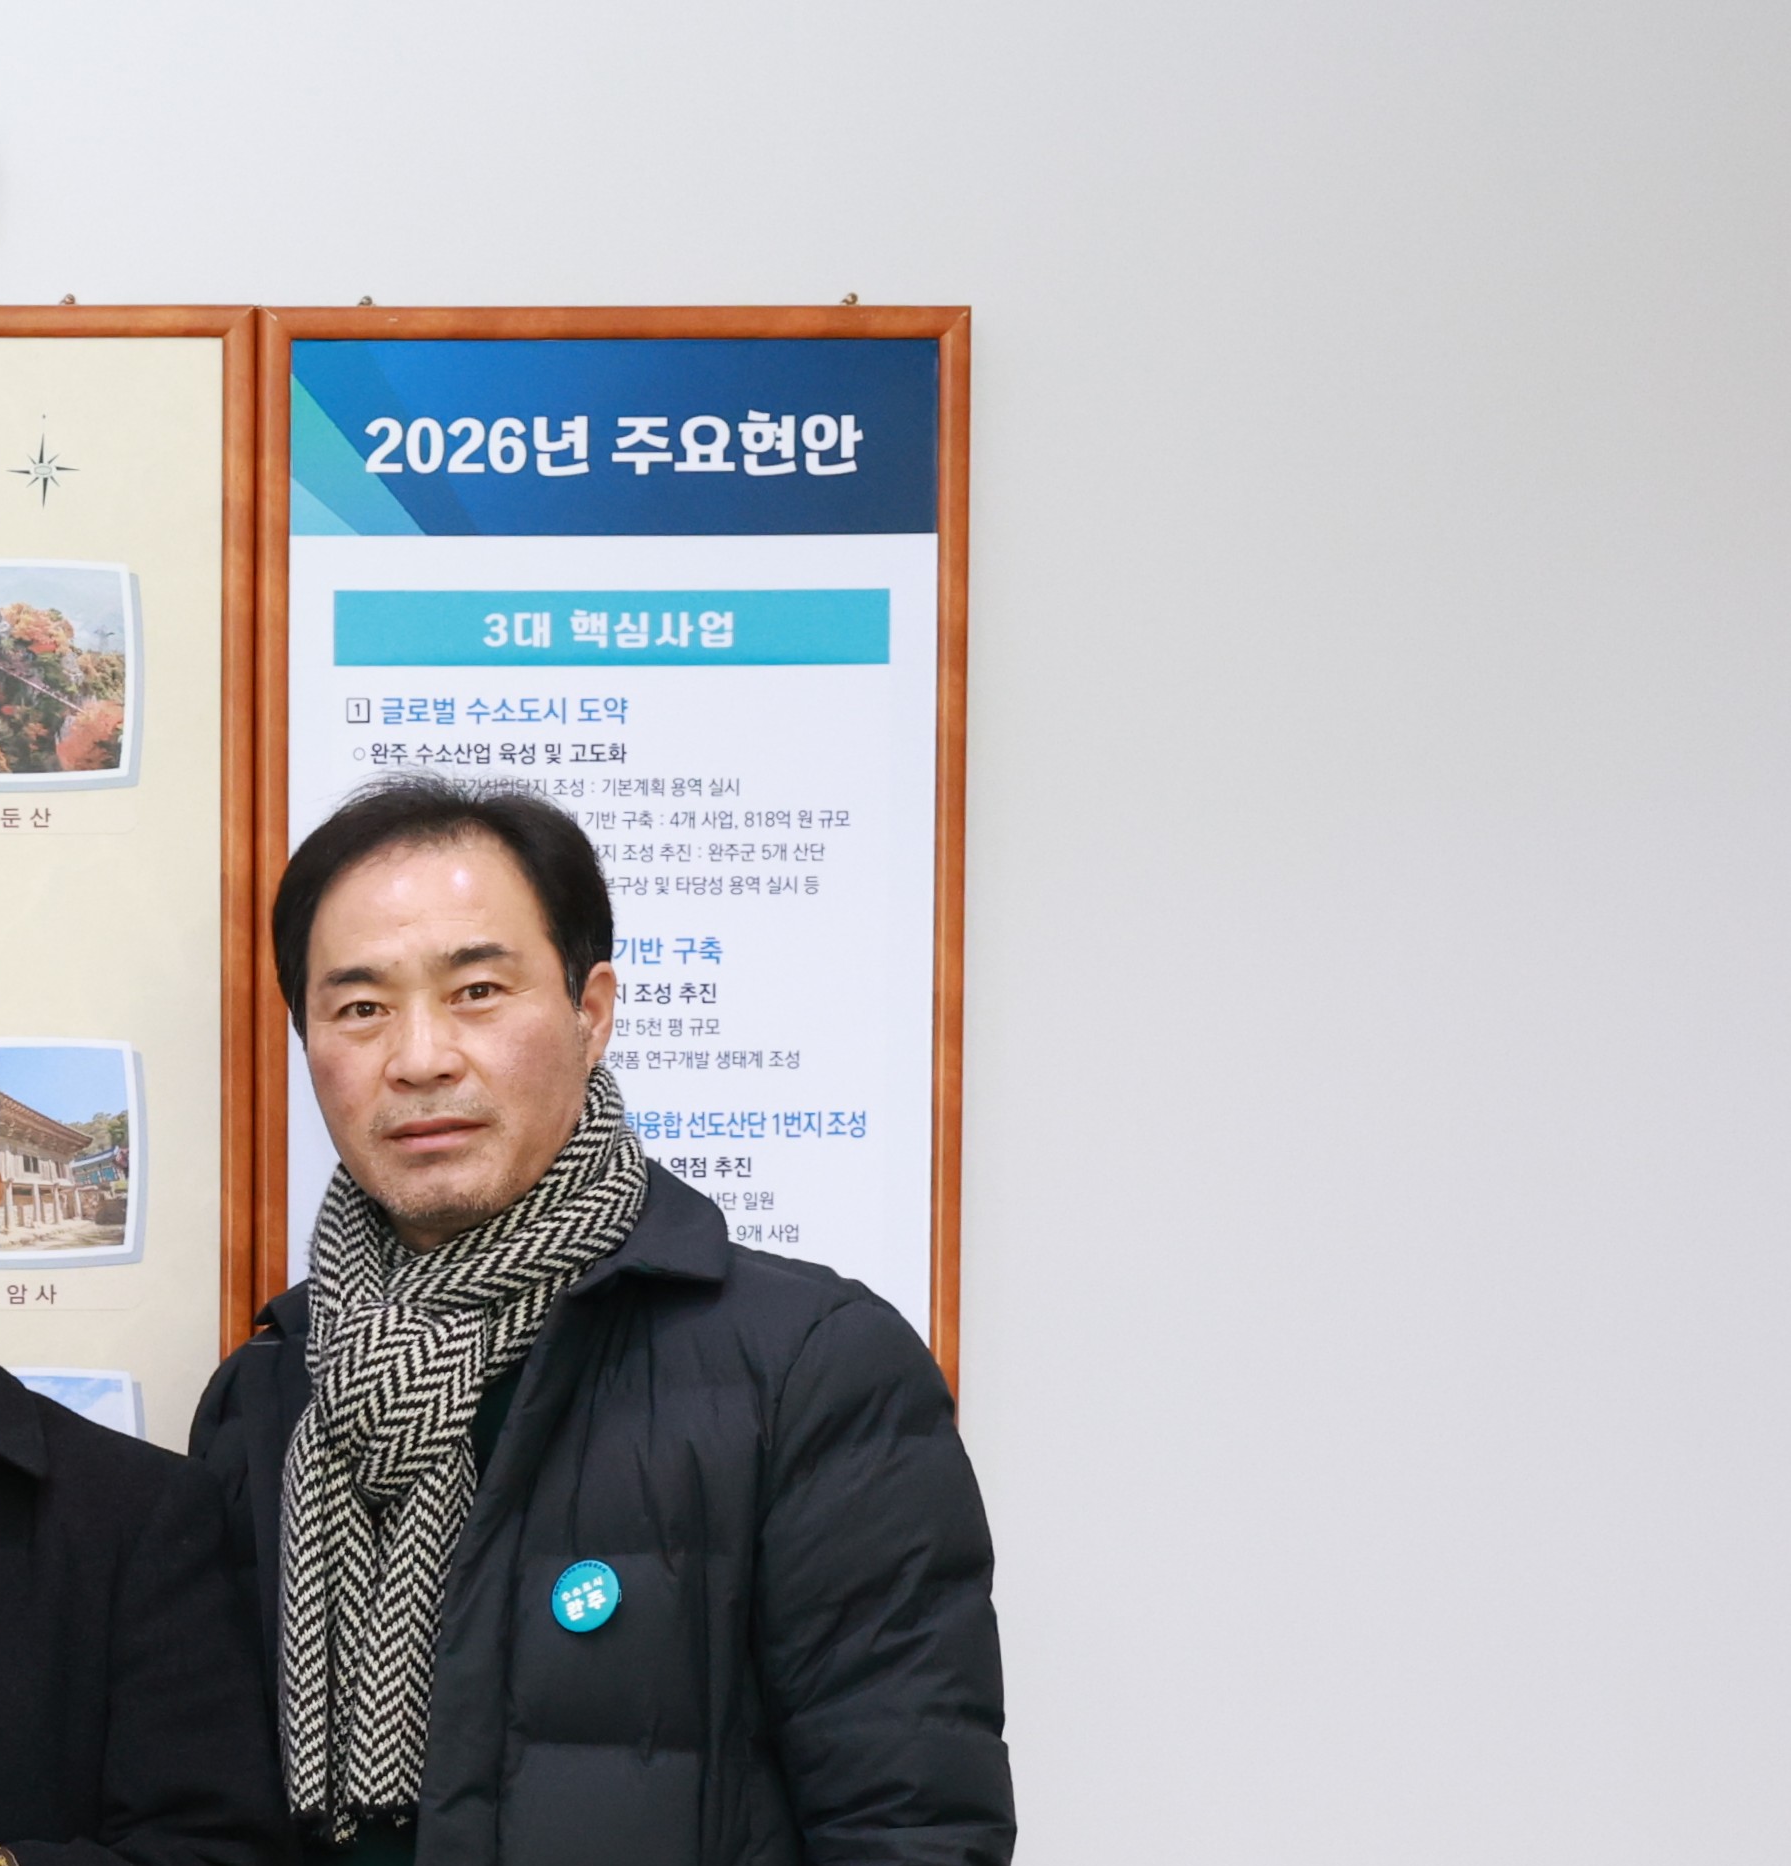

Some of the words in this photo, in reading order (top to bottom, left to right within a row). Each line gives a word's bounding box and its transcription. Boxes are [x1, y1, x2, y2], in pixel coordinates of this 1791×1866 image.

[364, 414, 590, 477] 2026년
[611, 409, 864, 477] 주요현안
[482, 611, 553, 650] 3대
[569, 608, 735, 651] 핵심사업
[379, 698, 456, 726] 글로벌
[466, 698, 568, 726] 수소도시
[576, 697, 630, 726] 도약
[370, 743, 408, 765] 완주
[415, 743, 491, 765] 수소산업
[499, 742, 536, 765] 육성
[544, 742, 562, 765] 및
[569, 742, 627, 765] 고도화
[553, 778, 585, 797] 조성
[602, 778, 666, 797] 기본계획
[670, 778, 703, 797] 용역
[708, 778, 741, 797] 실시
[585, 810, 617, 829] 기반
[621, 810, 654, 829] 구축
[669, 810, 697, 829] 4개
[701, 810, 739, 830] 사업,
[744, 810, 791, 829] 818억
[797, 810, 813, 829] 원
[818, 810, 851, 829] 규모
[622, 843, 654, 862] 조성
[659, 843, 691, 862] 추진
[707, 843, 756, 862] 완주군
[761, 843, 788, 862] 5개
[792, 843, 825, 862] 산단
[654, 877, 670, 896] 및
[675, 877, 724, 896] 타당성
[729, 877, 761, 896] 용역
[766, 876, 799, 896] 실시
[804, 876, 820, 895] 등
[613, 937, 663, 965] 기반
[672, 937, 724, 965] 구축
[634, 982, 672, 1004] 조성
[678, 982, 717, 1004] 추진
[636, 1018, 662, 1037] 5천
[668, 1018, 684, 1037] 평
[688, 1018, 721, 1037] 규모
[646, 1050, 710, 1070] 연구개발
[715, 1050, 763, 1070] 생태계
[768, 1050, 801, 1070] 조성
[687, 1110, 767, 1139] 선도산단
[771, 1110, 822, 1138] 1번지
[827, 1110, 866, 1138] 조성
[670, 1157, 707, 1179] 역점
[714, 1156, 752, 1178] 추진
[742, 1191, 774, 1211] 일원
[736, 1224, 763, 1243] 9개
[768, 1223, 800, 1243] 사업
